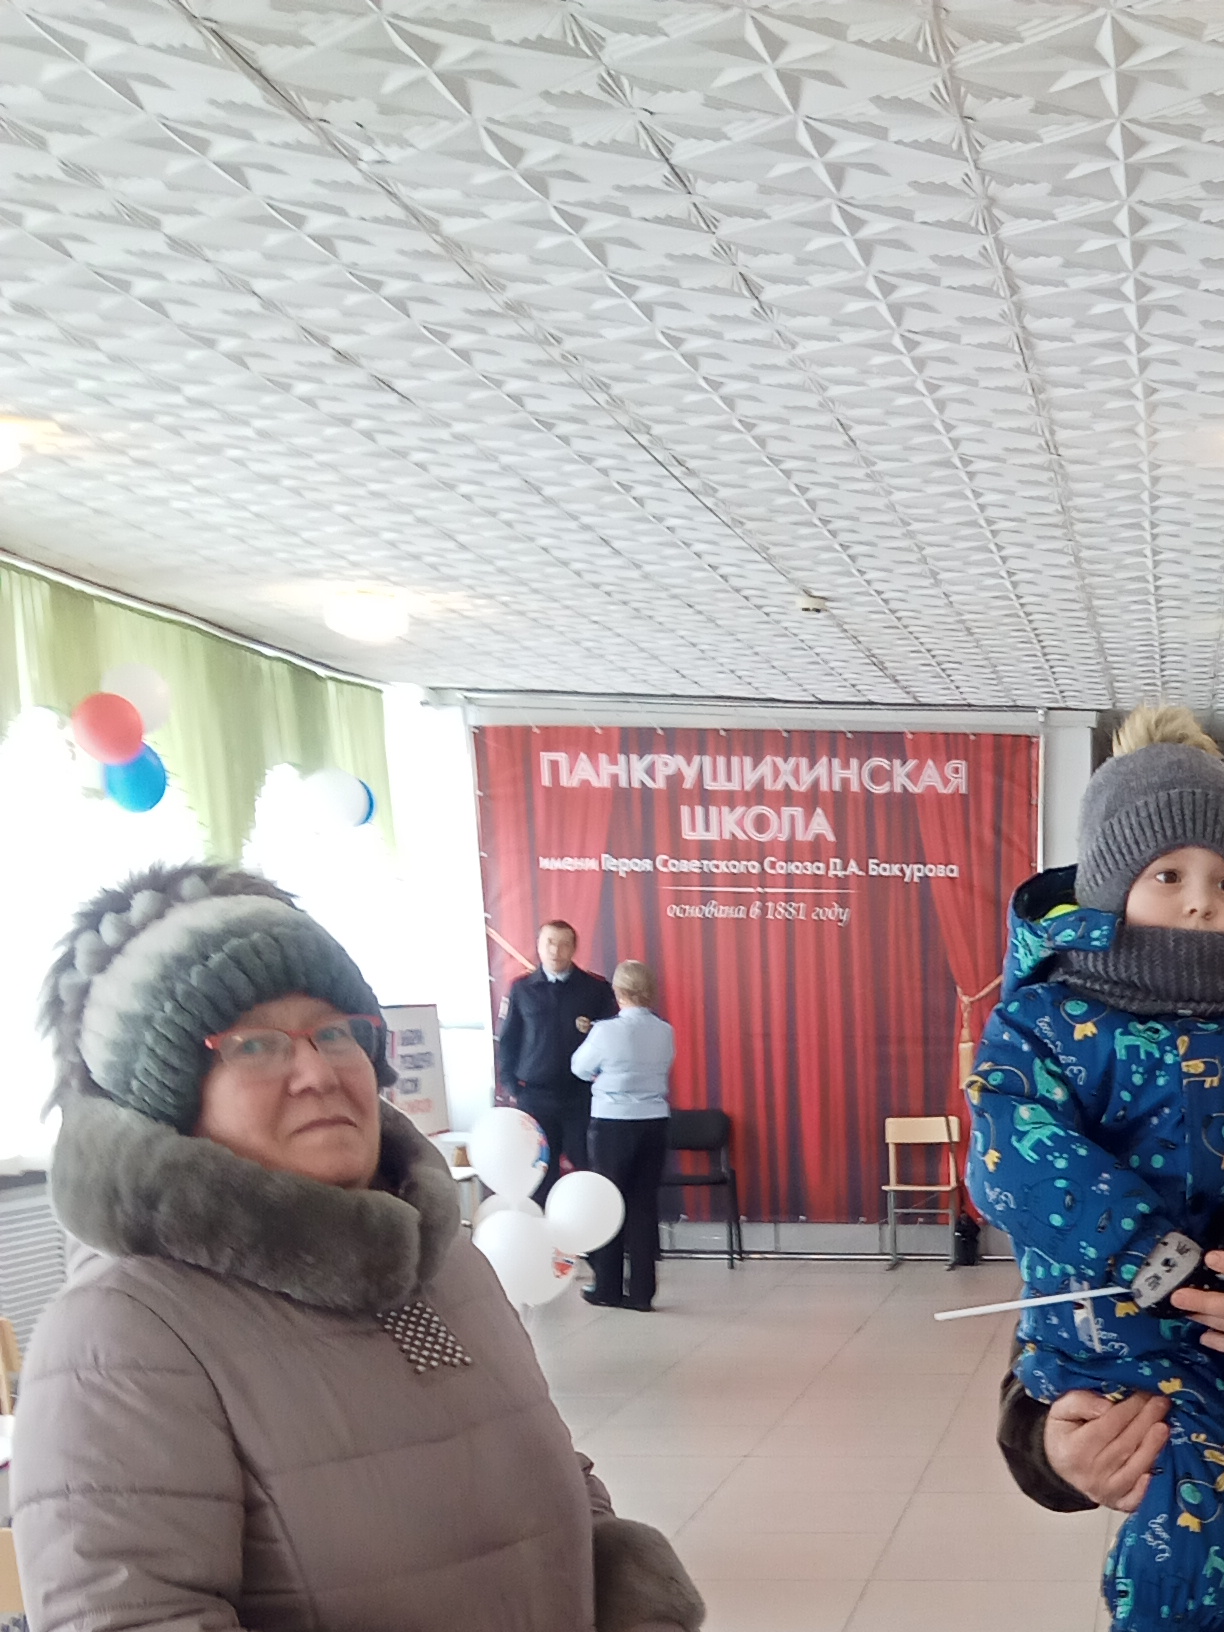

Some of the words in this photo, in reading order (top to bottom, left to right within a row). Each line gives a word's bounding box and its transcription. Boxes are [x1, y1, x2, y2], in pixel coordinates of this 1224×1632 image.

[539, 751, 969, 795] ПАНКРУШИХИНСКАЯ
[680, 804, 837, 842] ШКОЛА
[538, 855, 600, 872] имени
[600, 853, 654, 878] Героя
[655, 854, 762, 875] Советского
[763, 856, 826, 876] Союза
[868, 858, 960, 883] Бакурова
[666, 899, 747, 920] основана
[749, 900, 762, 920] в
[765, 901, 807, 920] 1881
[811, 902, 850, 927] году
